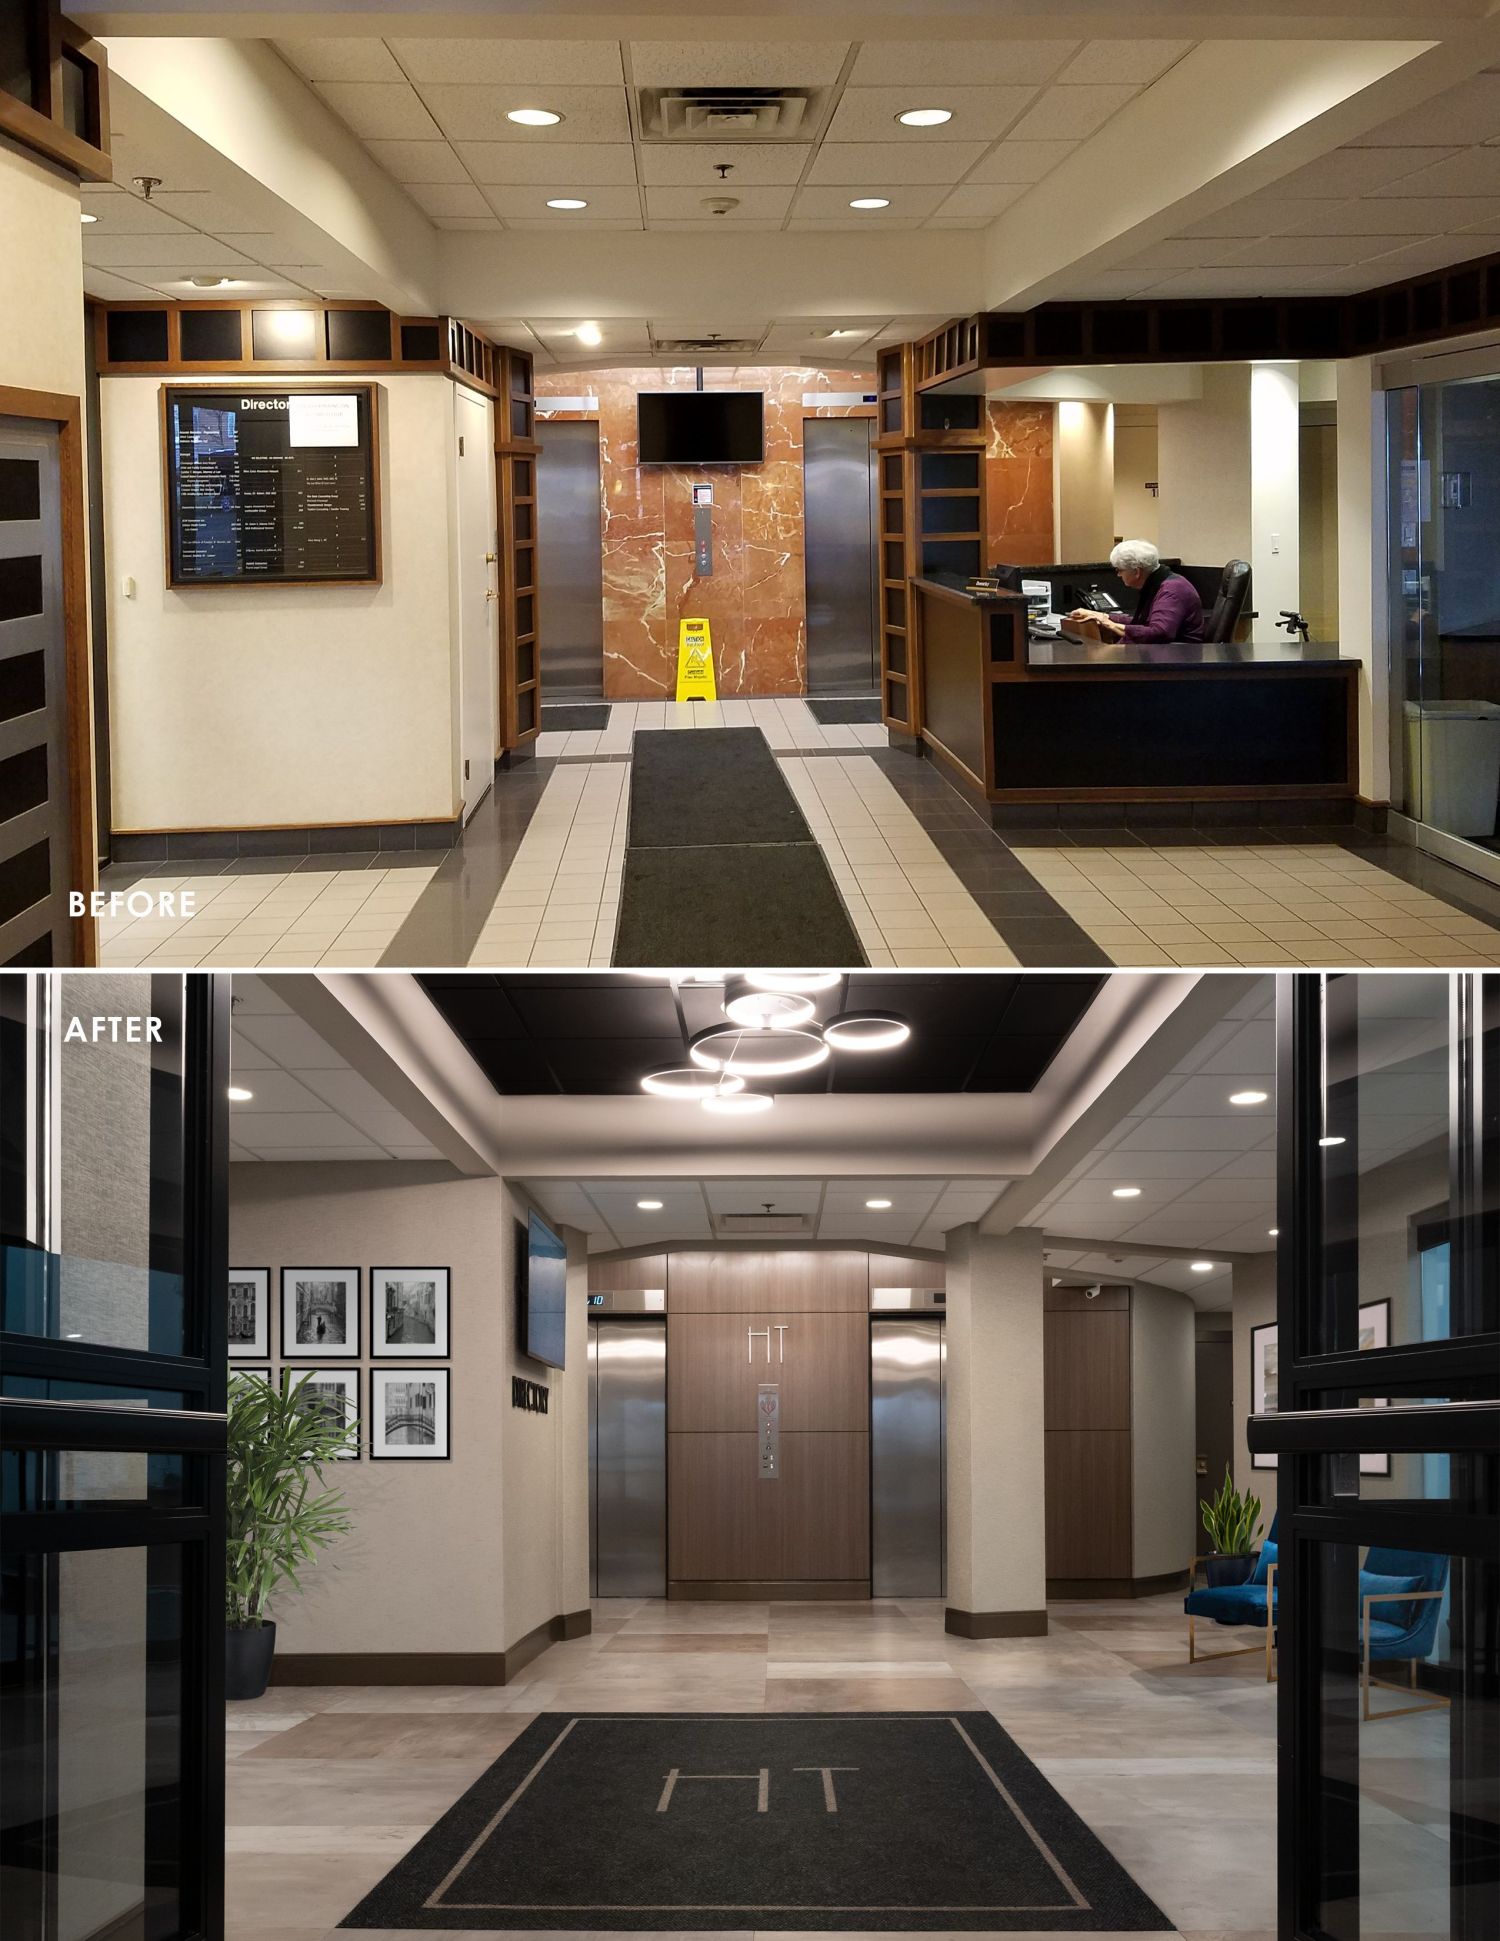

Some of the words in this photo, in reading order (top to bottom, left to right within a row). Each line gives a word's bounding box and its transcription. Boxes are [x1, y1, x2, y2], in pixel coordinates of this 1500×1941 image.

[241, 399, 290, 410] Director
[747, 1326, 789, 1363] HT
[656, 1767, 860, 1813] HT
